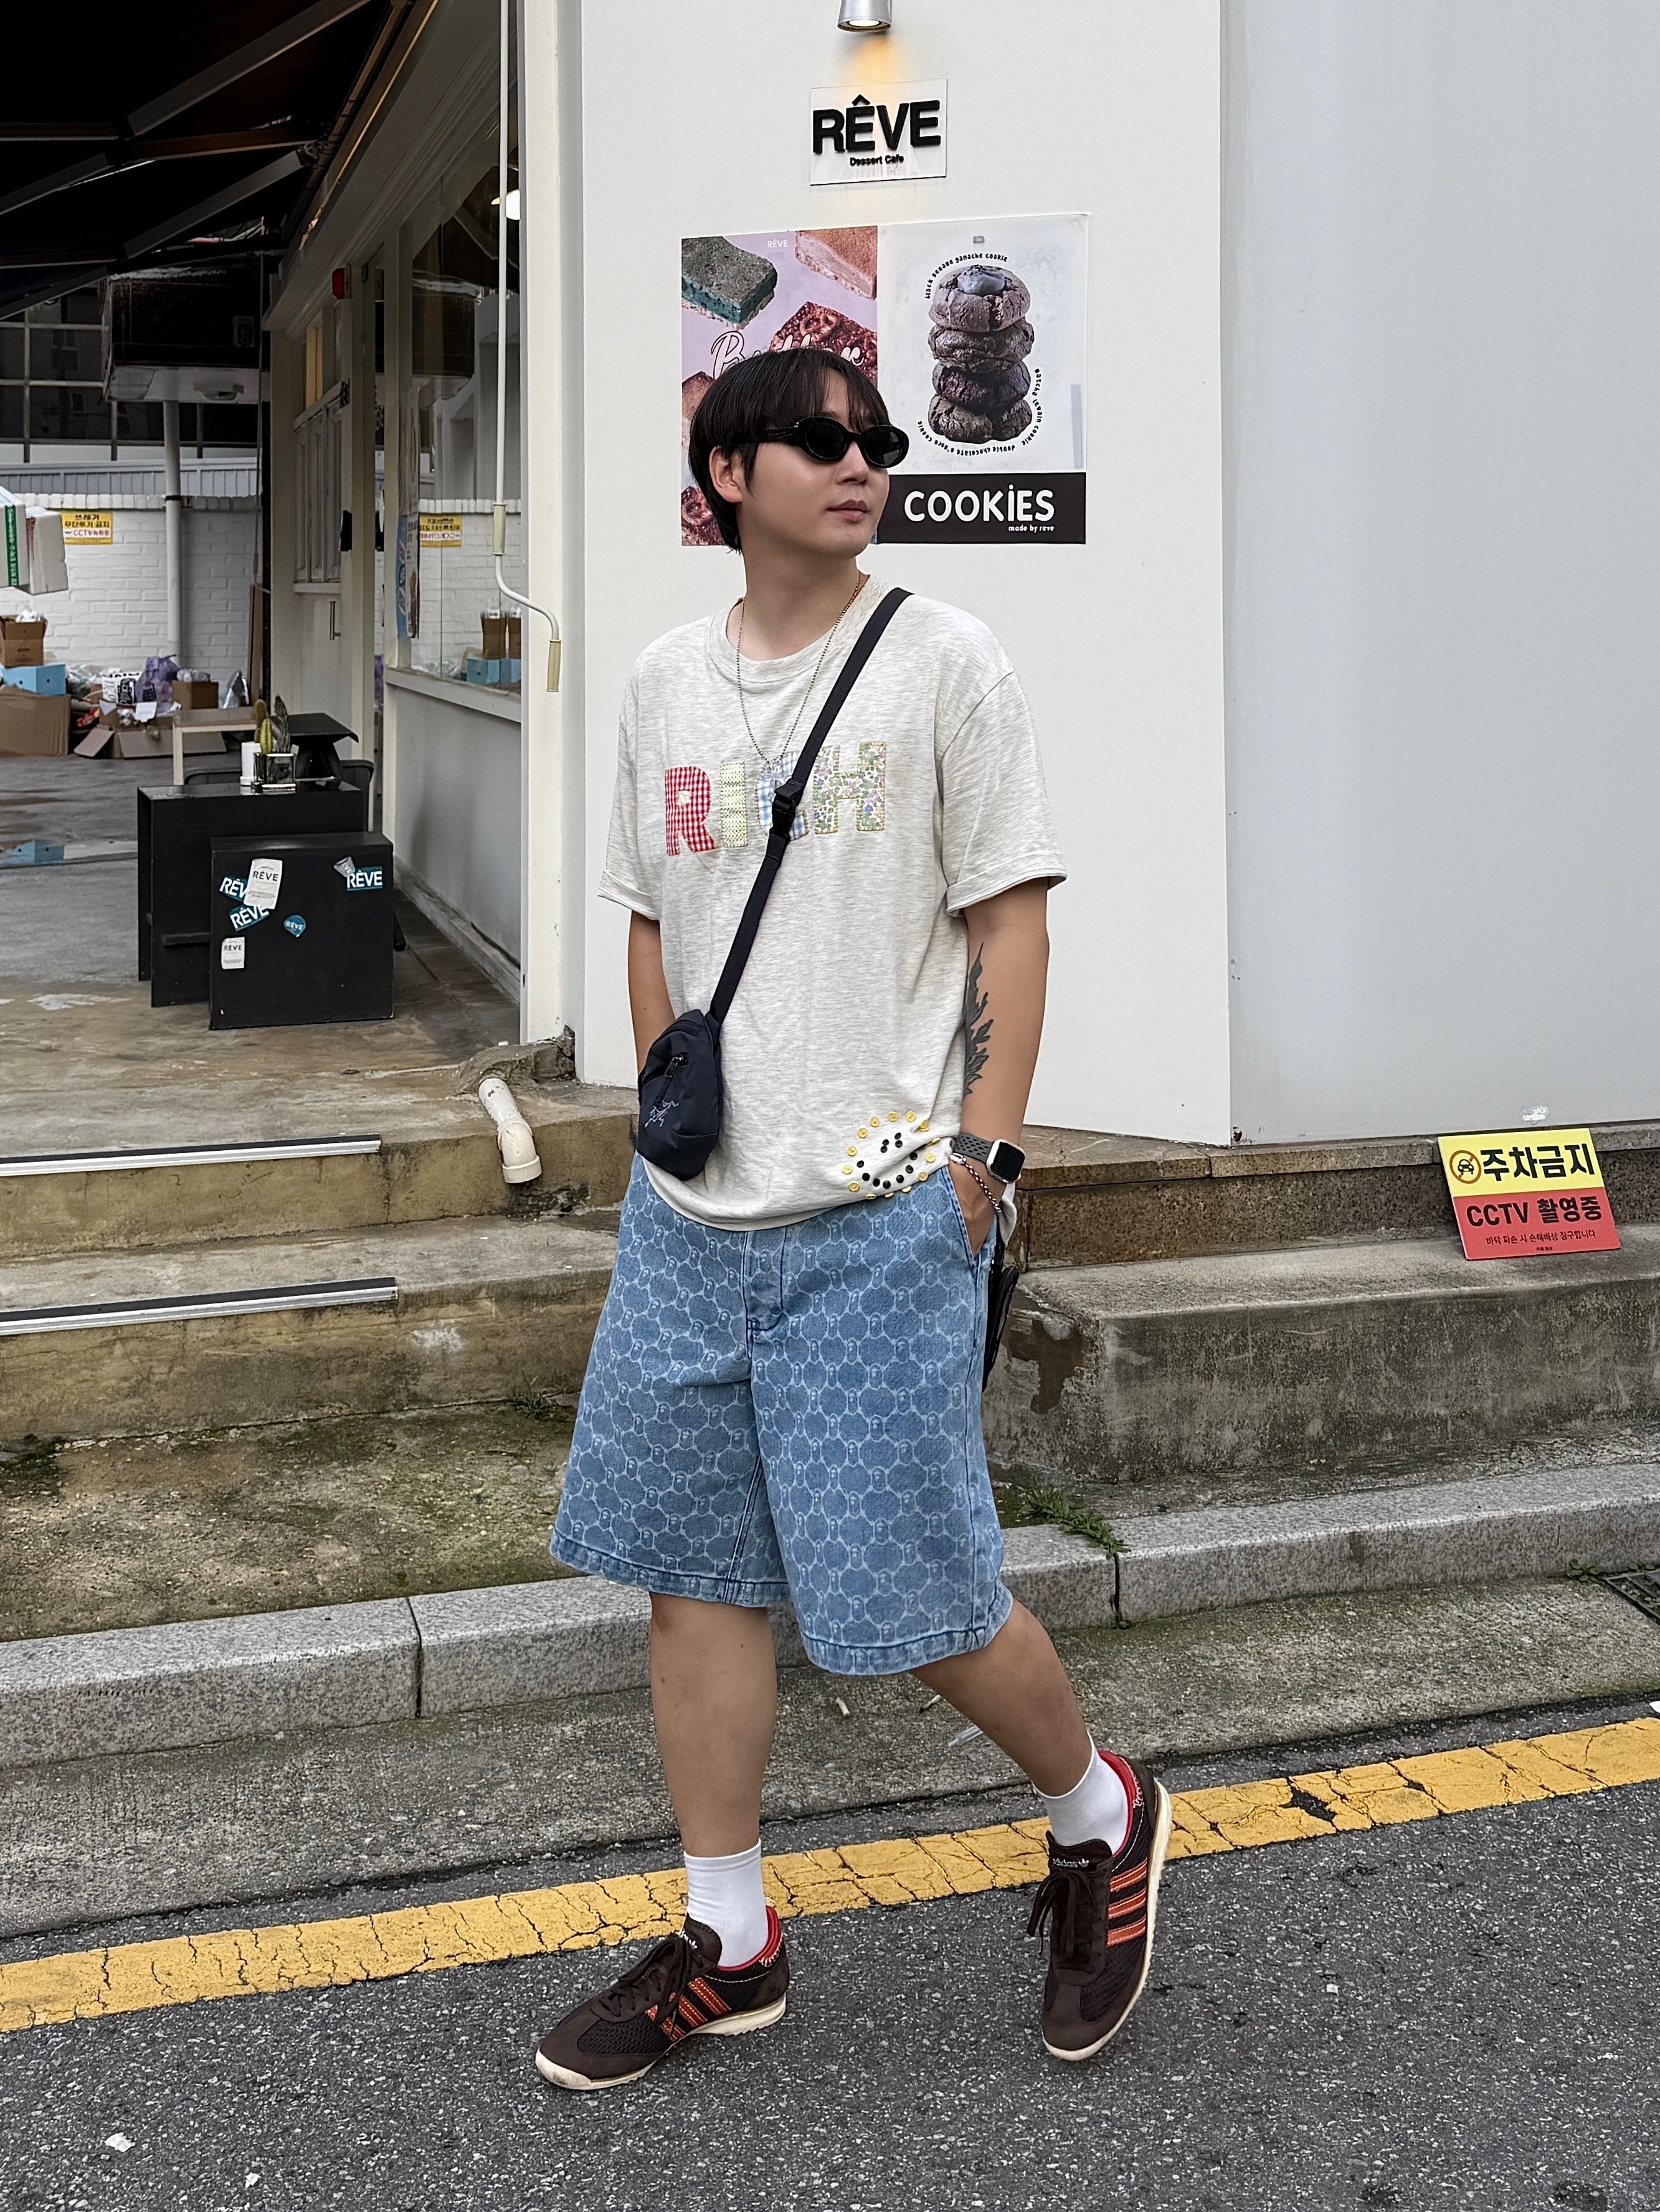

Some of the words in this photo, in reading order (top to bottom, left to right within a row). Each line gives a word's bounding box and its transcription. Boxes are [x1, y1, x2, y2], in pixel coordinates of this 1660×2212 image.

[813, 94, 941, 154] RÊVE
[850, 156, 883, 166] Dessert
[885, 154, 904, 164] Cafe
[932, 259, 954, 278] sesame
[955, 253, 983, 263] ganache
[985, 253, 1008, 262] cookie
[1032, 368, 1041, 396] matcha
[918, 421, 932, 442] cookie
[1022, 425, 1039, 445] cookie
[957, 447, 991, 456] chocolate
[1029, 524, 1038, 533] by
[219, 877, 247, 898] RÊV
[1480, 1143, 1595, 1181] 주차금지
[1466, 1202, 1528, 1227] CCTV
[1537, 1196, 1602, 1224] 촬영중
[1520, 1234, 1528, 1243] 시
[1529, 1231, 1558, 1242] 손해배상
